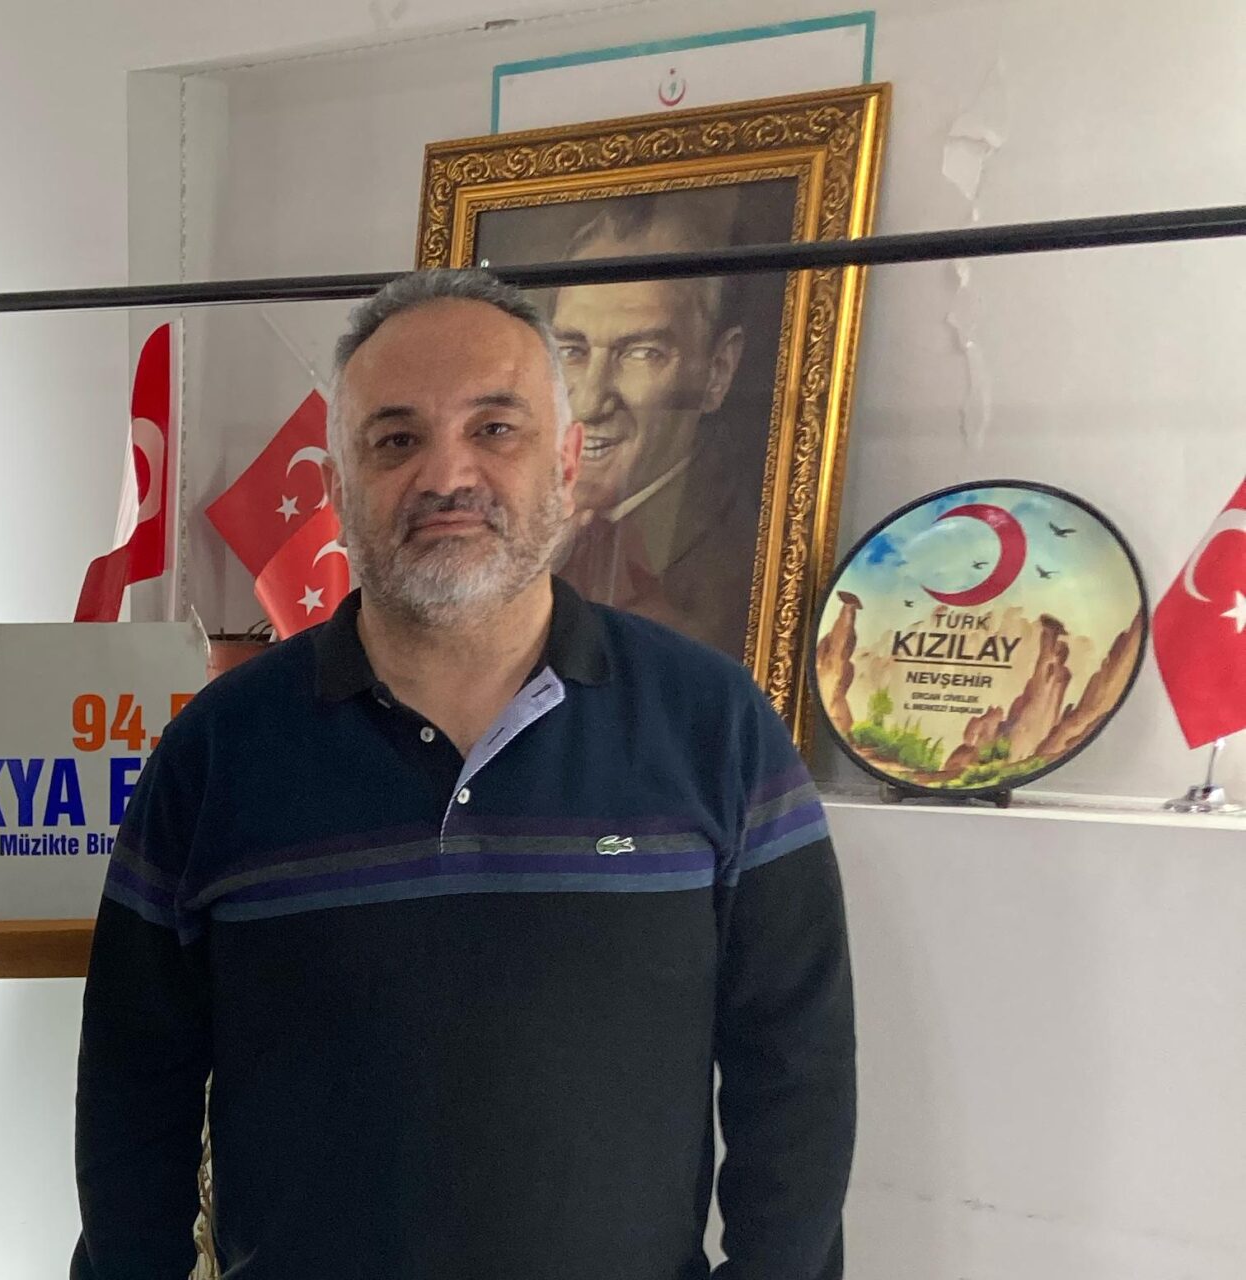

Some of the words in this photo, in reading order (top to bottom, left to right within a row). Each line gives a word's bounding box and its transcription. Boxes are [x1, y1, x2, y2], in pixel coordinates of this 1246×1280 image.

[934, 610, 992, 631] TÜRK
[891, 631, 1022, 662] KIZILAY
[906, 671, 993, 689] NEVŞEHİR
[109, 757, 142, 826] F
[0, 833, 79, 856] Müzikte
[86, 833, 114, 855] Bir
